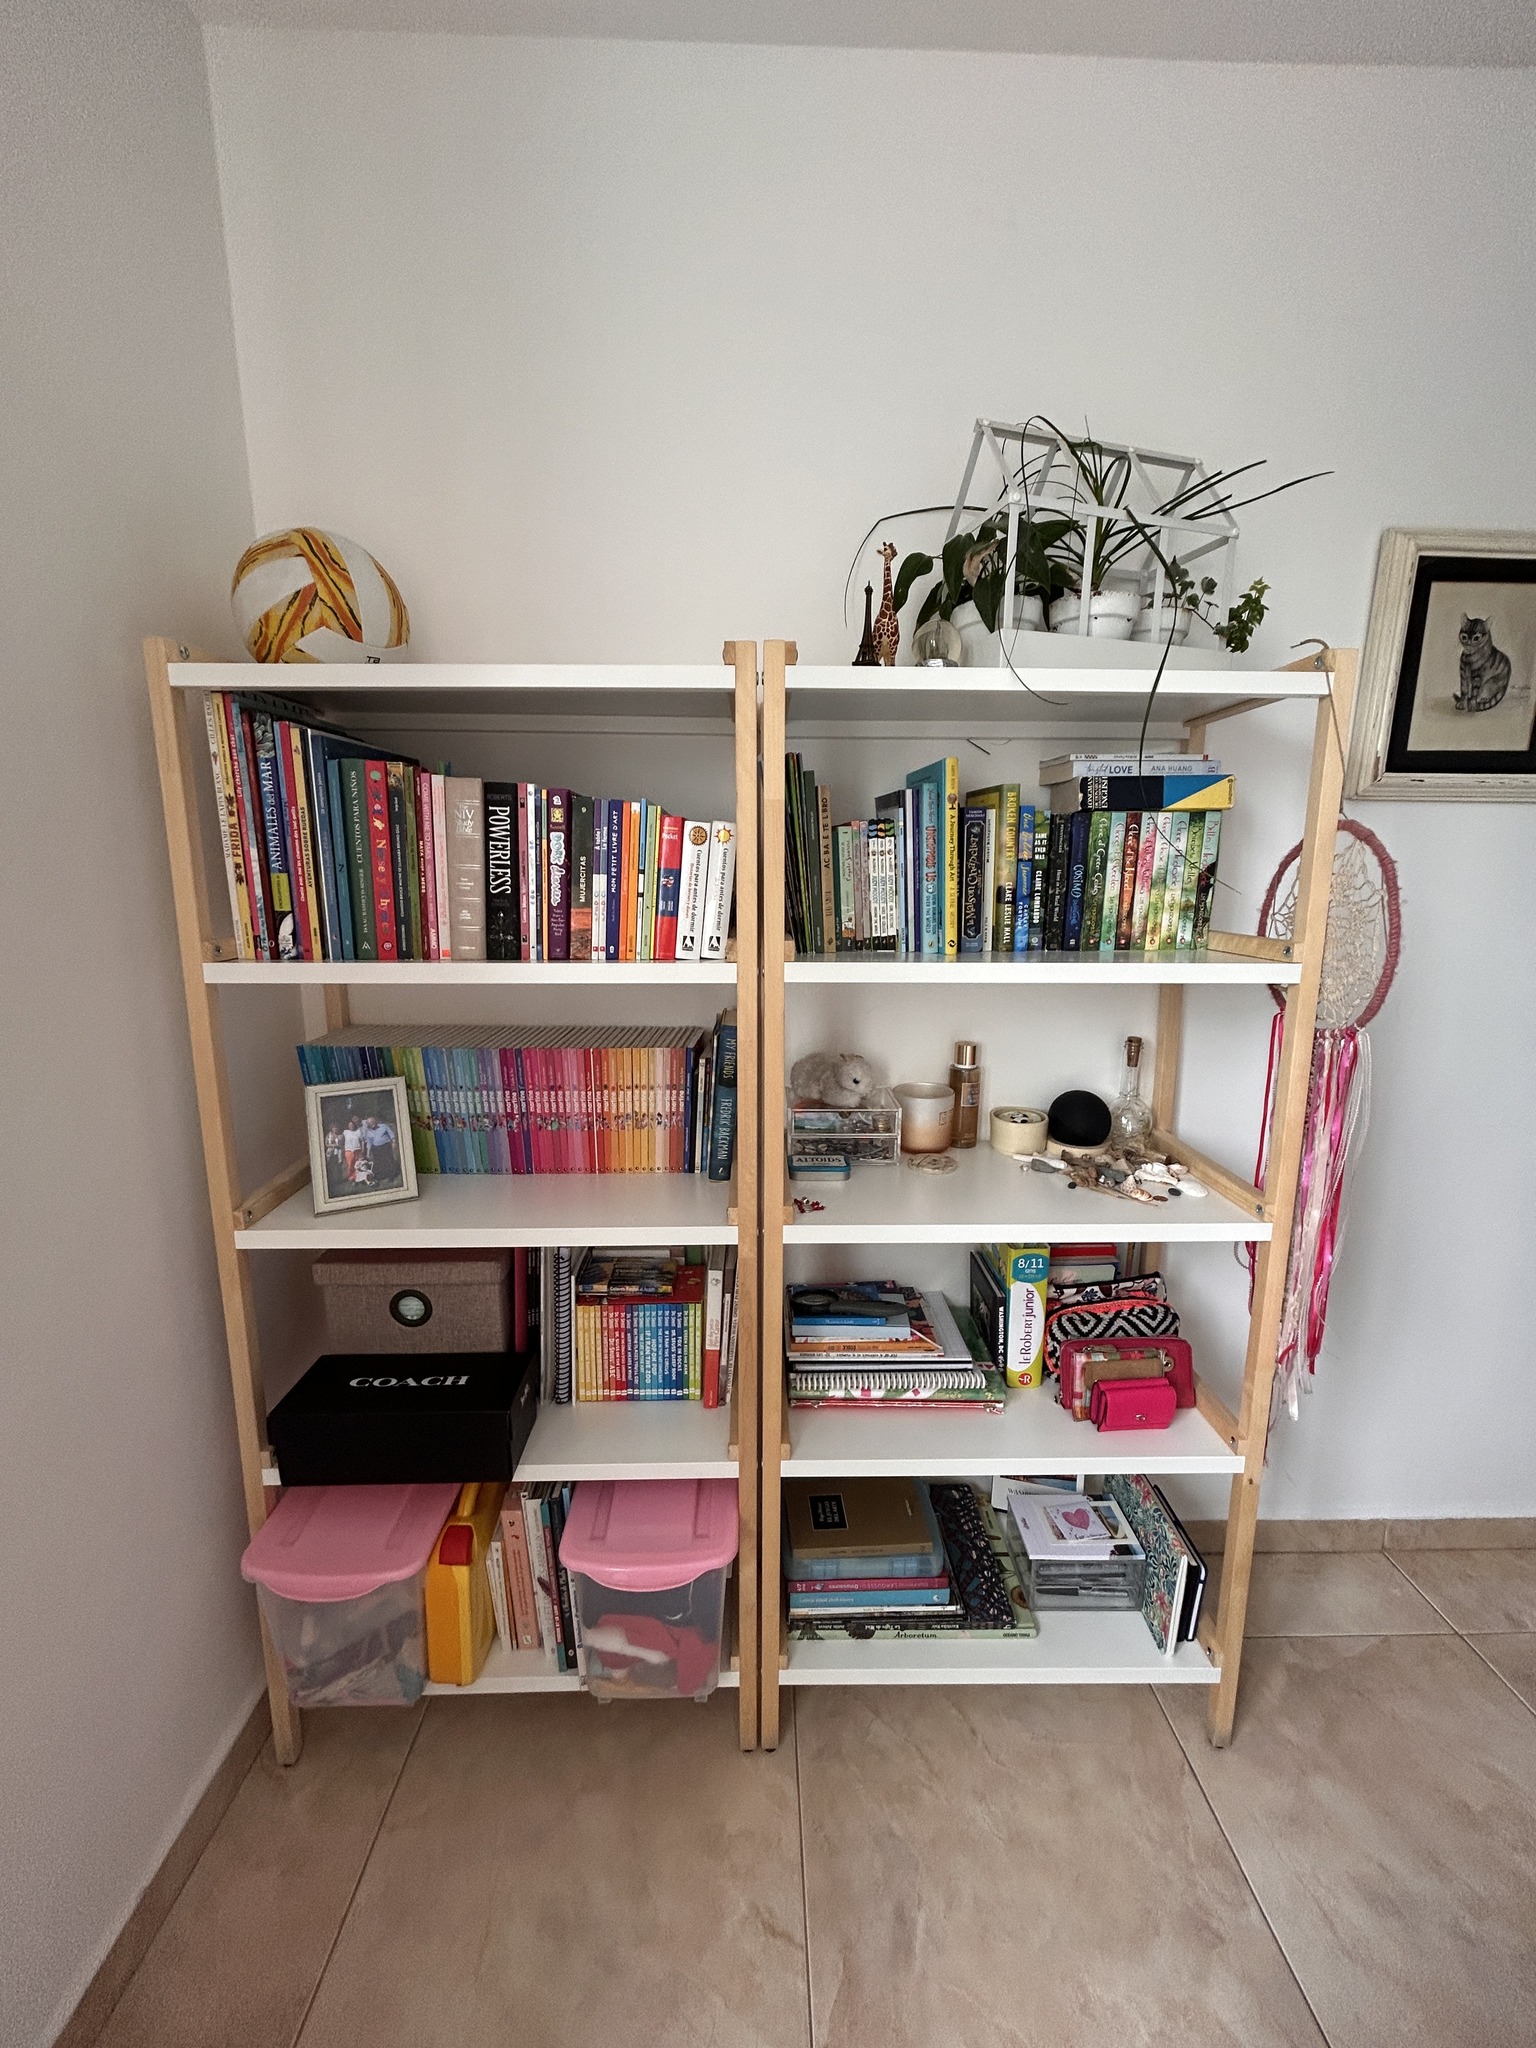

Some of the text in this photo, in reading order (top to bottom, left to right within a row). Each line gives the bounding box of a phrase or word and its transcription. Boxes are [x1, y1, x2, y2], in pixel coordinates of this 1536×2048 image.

[1109, 766, 1133, 774] LOVE
[422, 783, 430, 802] COME
[259, 760, 282, 870] ANIMALES del MAR
[300, 806, 308, 831] RUEDAS
[349, 770, 364, 864] CUENTOS PARA NIÑOS
[455, 809, 474, 819] NIV
[1023, 812, 1034, 829] One
[424, 822, 431, 831] ME
[425, 832, 432, 841] TO
[1004, 791, 1017, 862] BROKEN COUNTRY
[229, 822, 241, 858] FRIDA
[425, 841, 433, 860] PARIS
[488, 805, 512, 894] POWERLESS
[550, 832, 565, 866] DORK
[695, 849, 703, 873] Cuentos
[721, 848, 729, 871] Cuentos
[925, 825, 937, 882] UNSTOPPABLE US
[967, 834, 980, 886] Chapelier
[305, 853, 314, 887] AVENTURAS
[579, 855, 587, 902] MUJERCITAS
[1020, 863, 1032, 896] Summer
[717, 902, 724, 910] de
[966, 886, 977, 920] Maison
[1033, 870, 1042, 924] CLAIRE LOMBARDO
[689, 912, 697, 932] dormir
[716, 911, 724, 931] dormir
[1003, 881, 1013, 944] CLARE LESLIE HALL
[429, 928, 438, 950] AMMO
[724, 1038, 736, 1079] MY FRIENDS
[429, 1089, 437, 1112] martine
[436, 1090, 444, 1113] martine
[443, 1090, 451, 1113] martine
[496, 1090, 504, 1113] martine
[511, 1092, 519, 1114] martine
[519, 1090, 527, 1113] martine
[717, 1098, 733, 1160] FREDRIK BACKMAN
[796, 1156, 842, 1164] ALTOIDS
[1017, 1258, 1044, 1269] 8/11
[1021, 1288, 1036, 1319] junior
[997, 1306, 1005, 1346] WASHINGTON,
[349, 1375, 471, 1388] COACH
[893, 1630, 937, 1639] Arboretum
